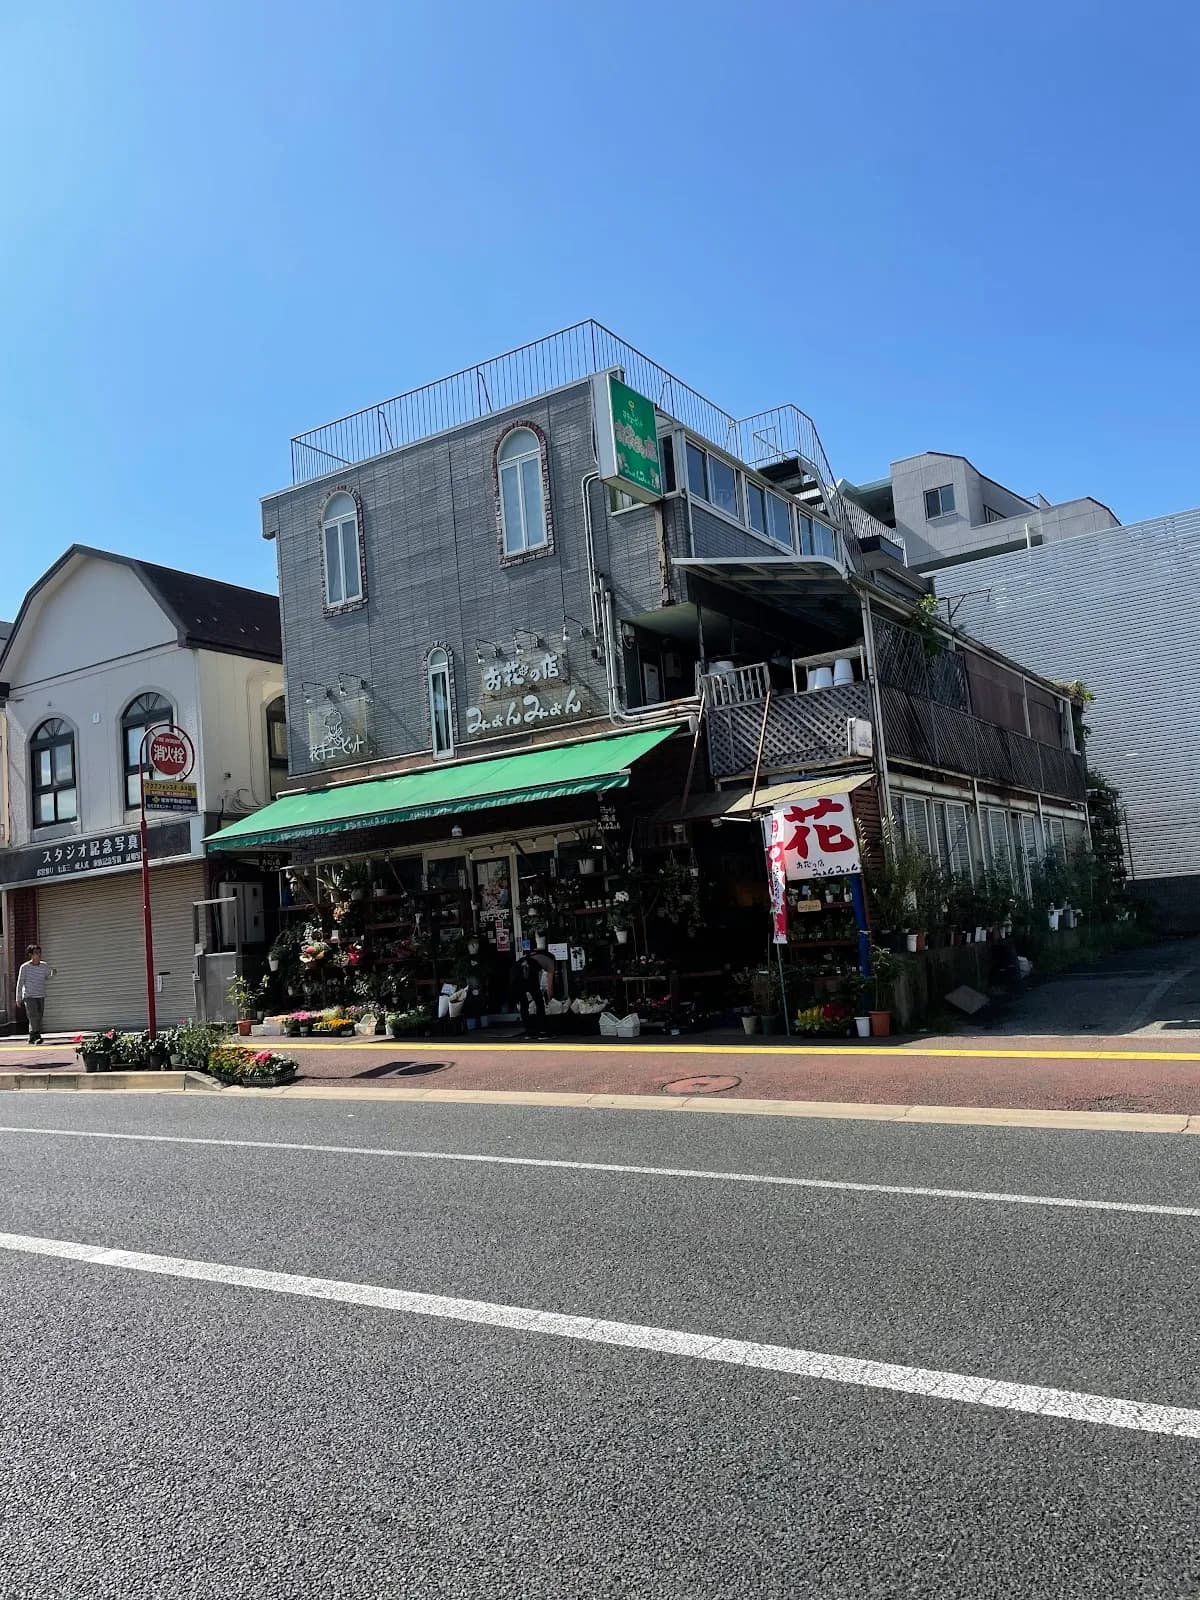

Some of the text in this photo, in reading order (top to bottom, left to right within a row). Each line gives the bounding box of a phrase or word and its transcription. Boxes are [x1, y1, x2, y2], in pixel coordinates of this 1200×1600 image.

[484, 653, 559, 691] お花の店
[466, 688, 581, 734] みょんみょん
[153, 744, 185, 763] 消火栓
[784, 798, 855, 860] 花
[42, 834, 139, 864] スタジオ記念写真
[812, 863, 858, 877] みょんみょん
